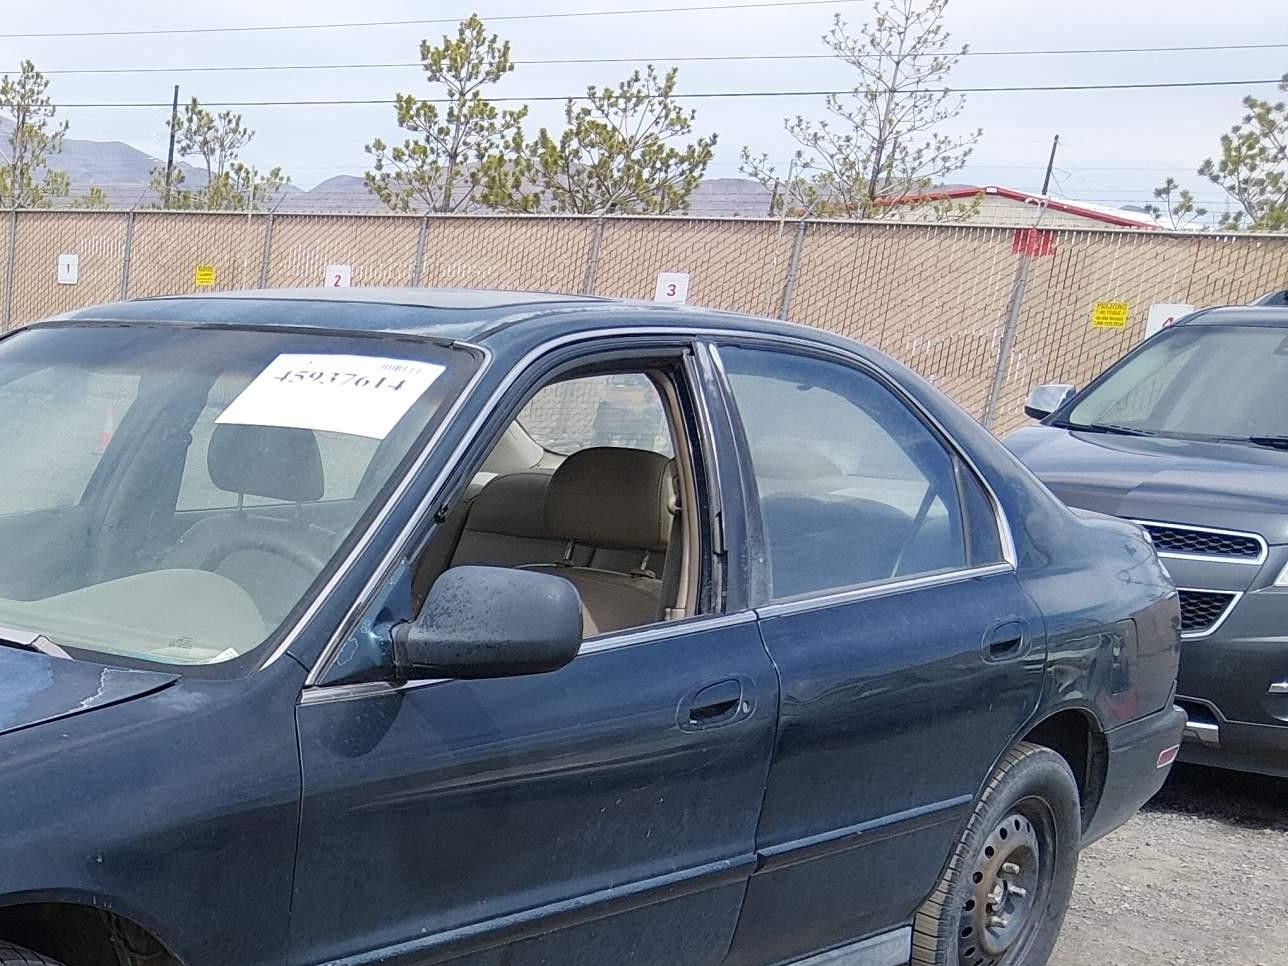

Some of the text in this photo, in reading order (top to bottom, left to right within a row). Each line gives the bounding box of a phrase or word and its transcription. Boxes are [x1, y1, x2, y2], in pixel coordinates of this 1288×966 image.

[66, 263, 71, 274] 1
[334, 274, 342, 287] 2
[666, 283, 677, 297] 3
[275, 370, 407, 391] 45937614
